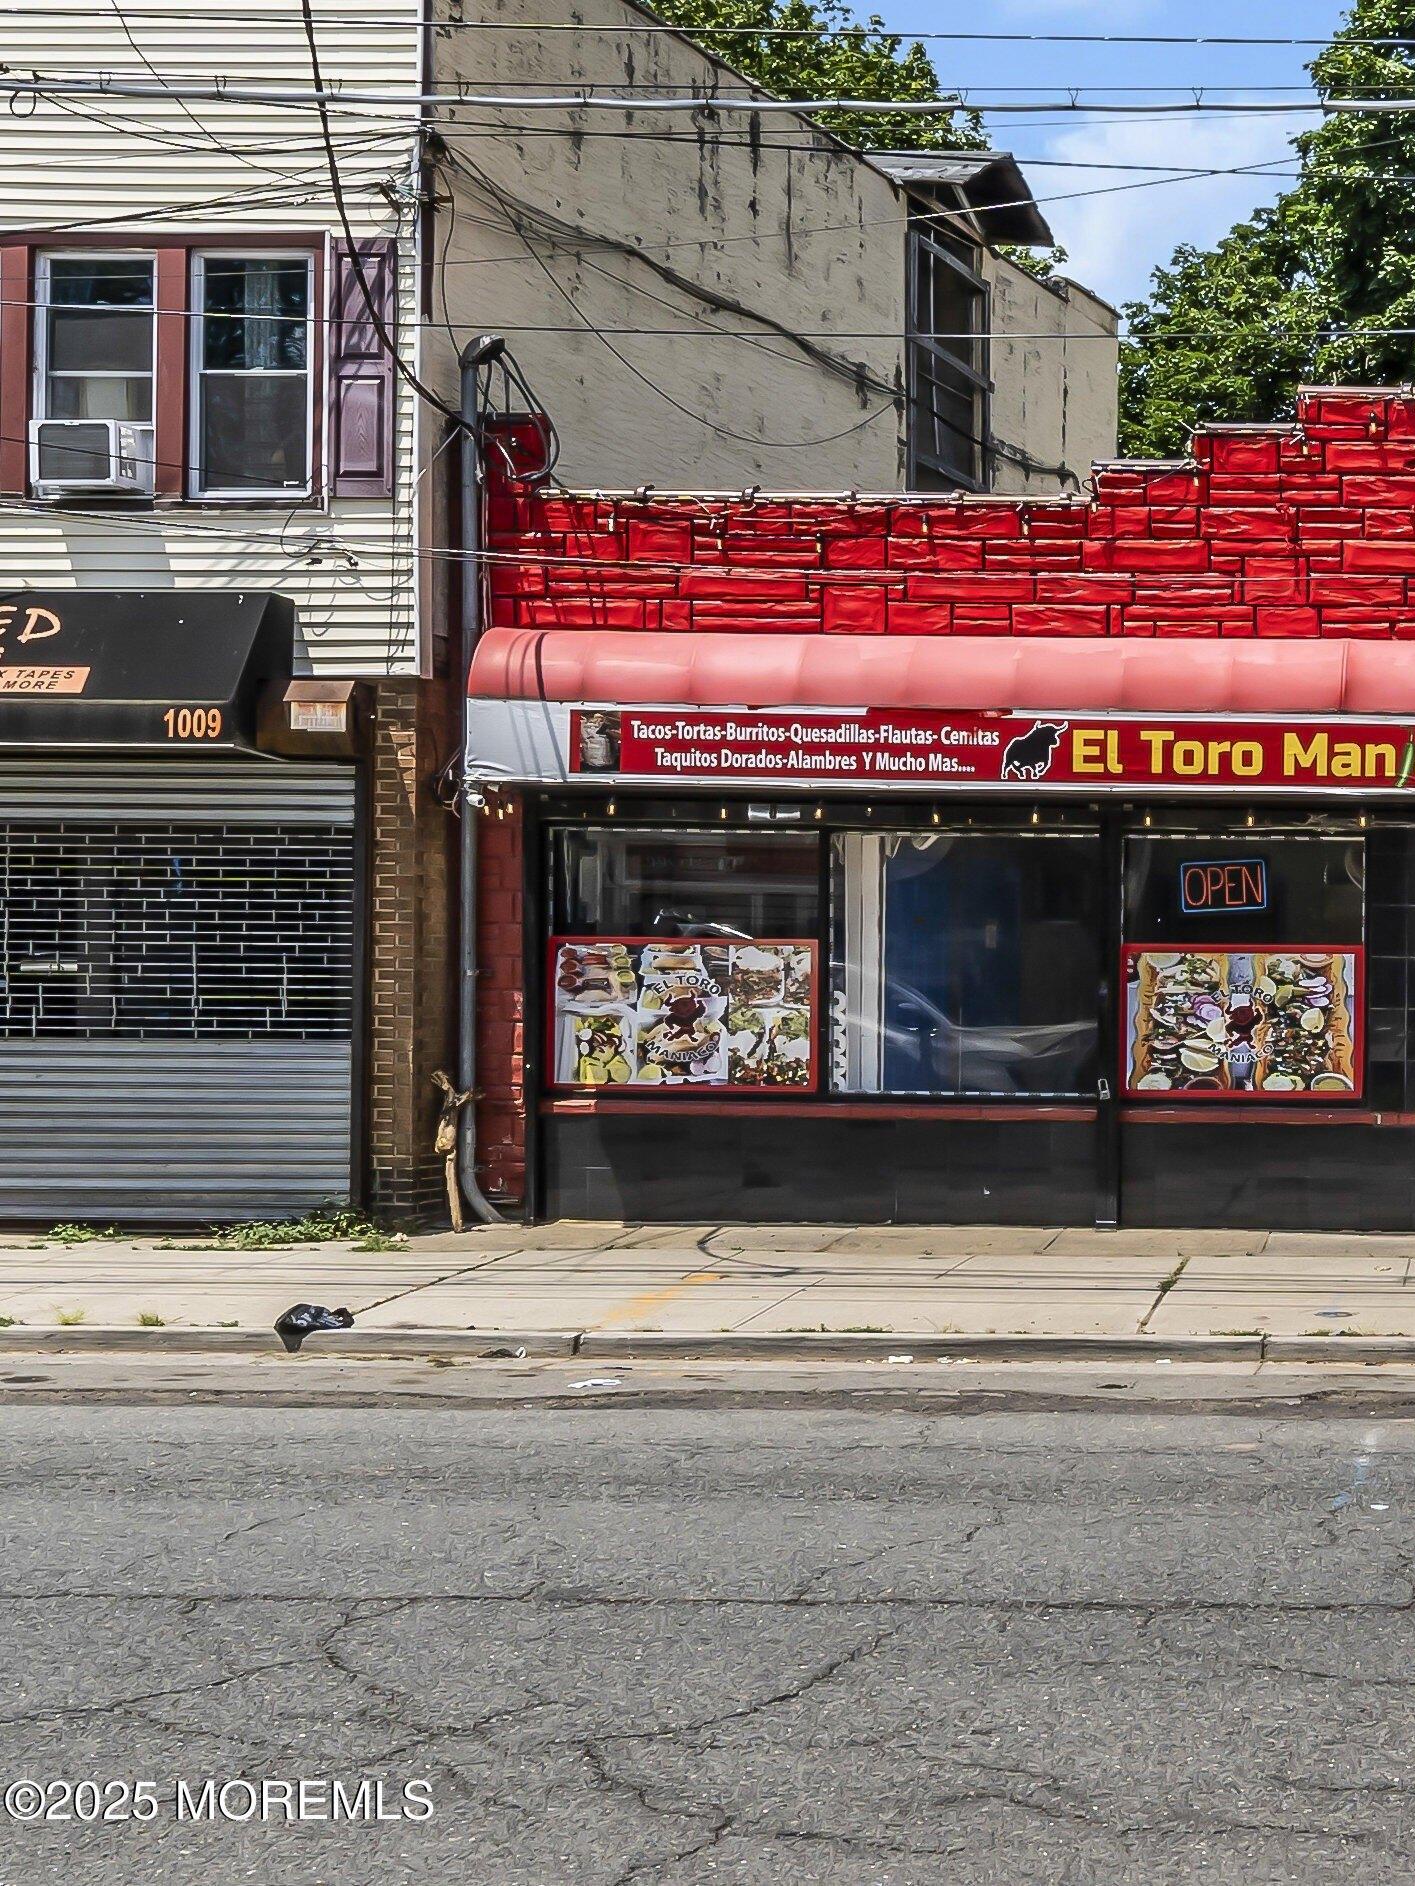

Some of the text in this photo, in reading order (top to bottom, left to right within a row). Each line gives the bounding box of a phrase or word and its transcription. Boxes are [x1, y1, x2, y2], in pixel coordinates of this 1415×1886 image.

[16, 669, 76, 679] TAPES
[3, 681, 58, 689] MORE
[163, 708, 222, 738] 1009
[654, 747, 718, 771] Taquitos
[720, 748, 857, 770] Dorados-Alambres
[862, 752, 873, 769] Y
[875, 752, 925, 771] Mucho
[1072, 729, 1123, 774] El
[1141, 730, 1264, 776] Toro
[1184, 864, 1262, 906] OPEN
[653, 975, 722, 996] EL TORO
[1211, 983, 1273, 1004] EL TORO
[646, 1040, 718, 1062] MANIACO
[1207, 1043, 1274, 1063] MANIACO
